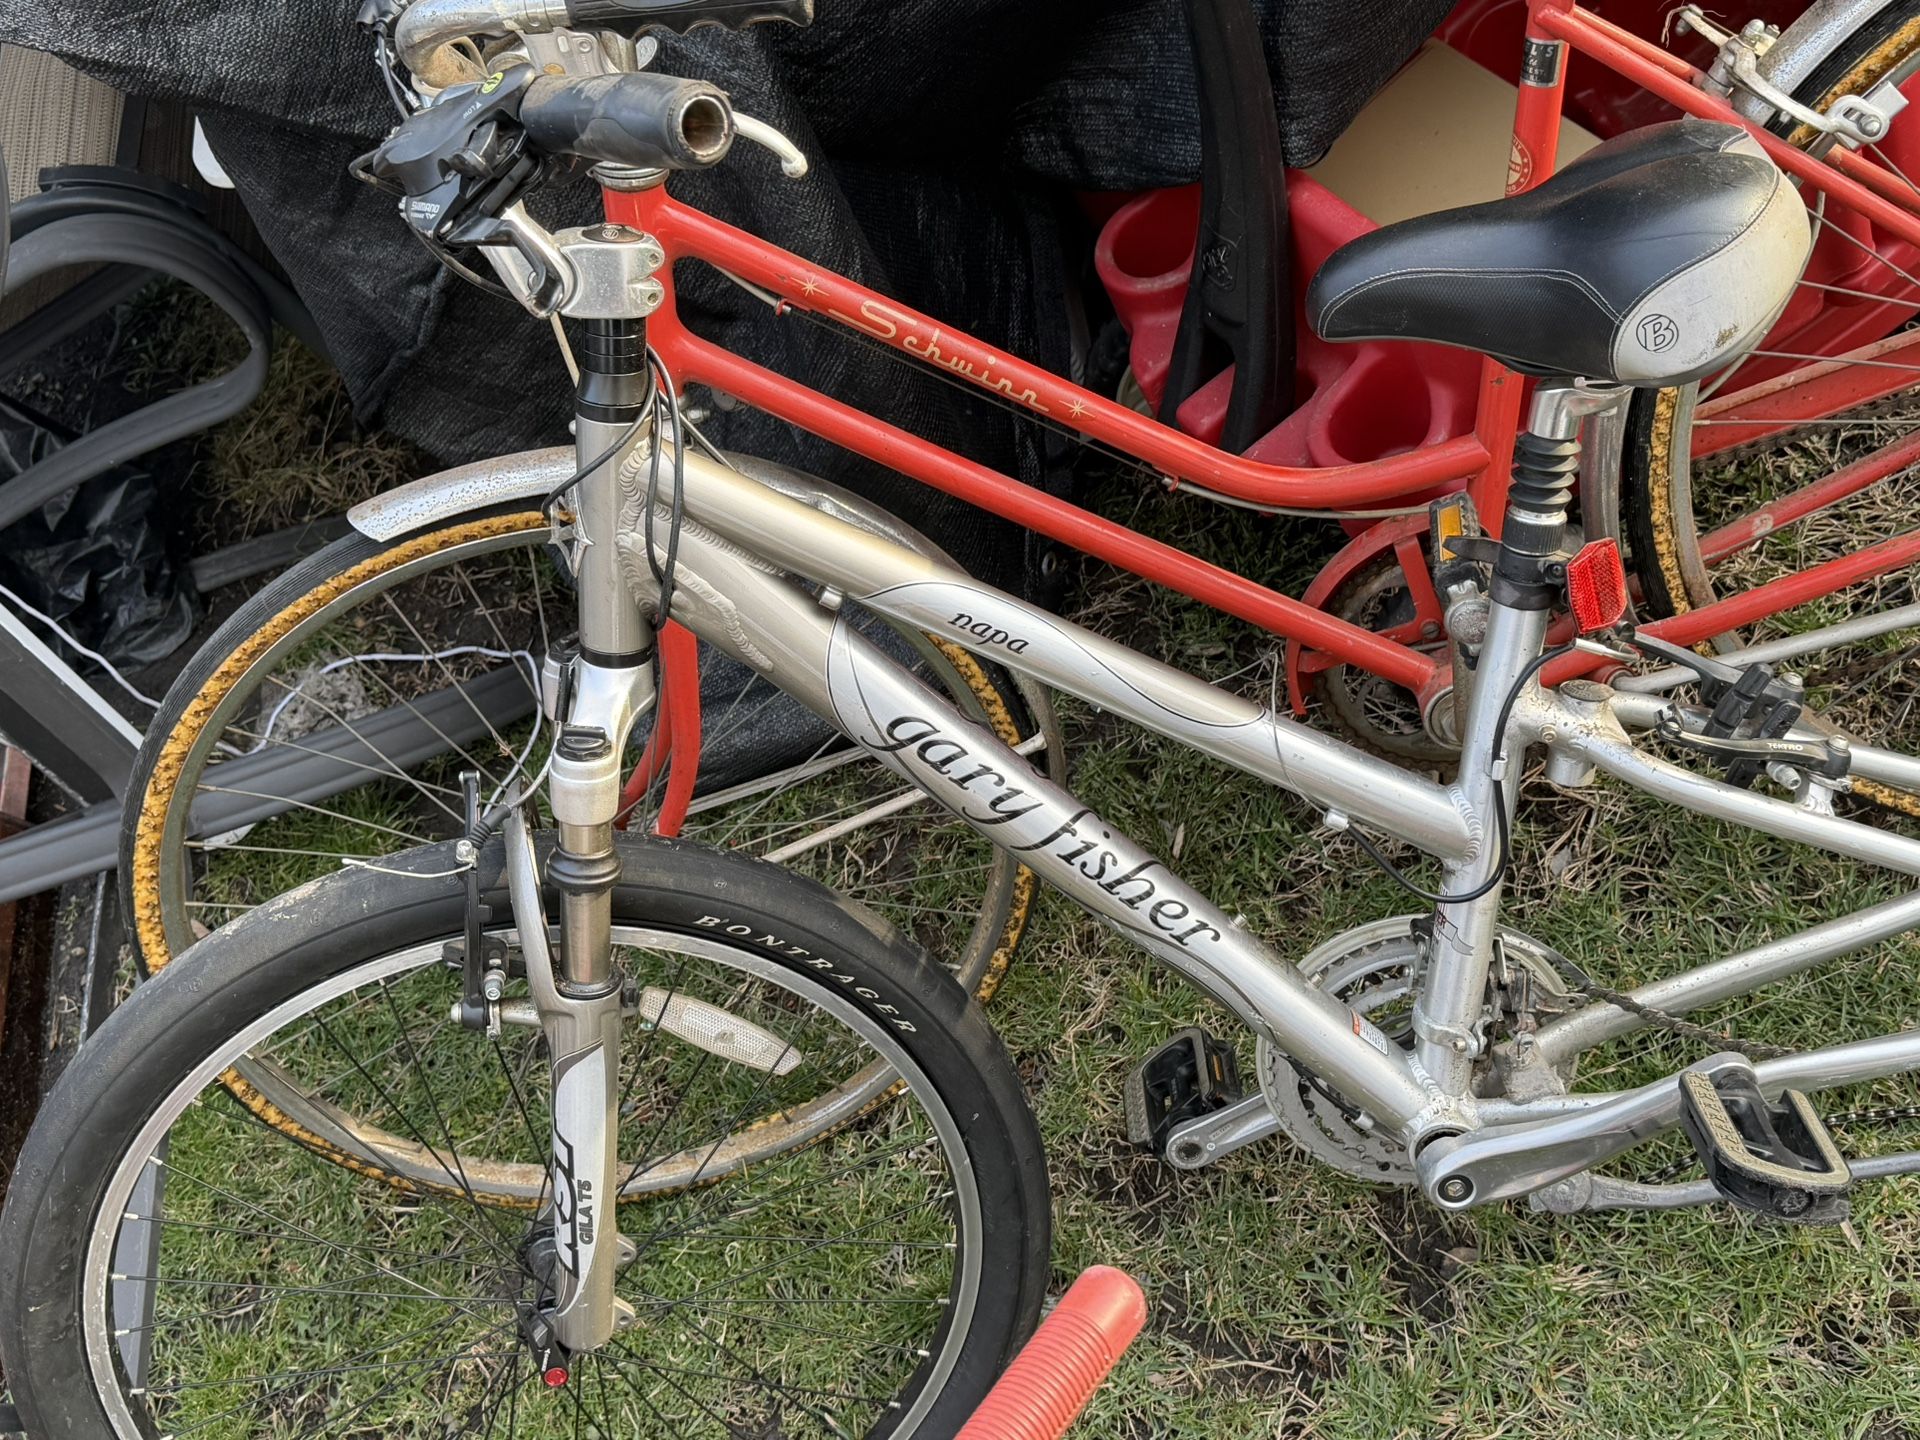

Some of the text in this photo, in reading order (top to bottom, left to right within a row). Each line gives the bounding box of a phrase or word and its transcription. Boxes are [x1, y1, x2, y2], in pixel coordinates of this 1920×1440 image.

[411, 201, 440, 213] SHIMANO
[828, 299, 1049, 412] Schwinn
[1640, 314, 1675, 352] B
[947, 613, 1030, 655] napa
[1766, 742, 1804, 751] TEKTRO
[860, 716, 1222, 947] gary fisher
[692, 914, 918, 1034] BONTRAGER
[577, 1178, 595, 1246] GILA T5
